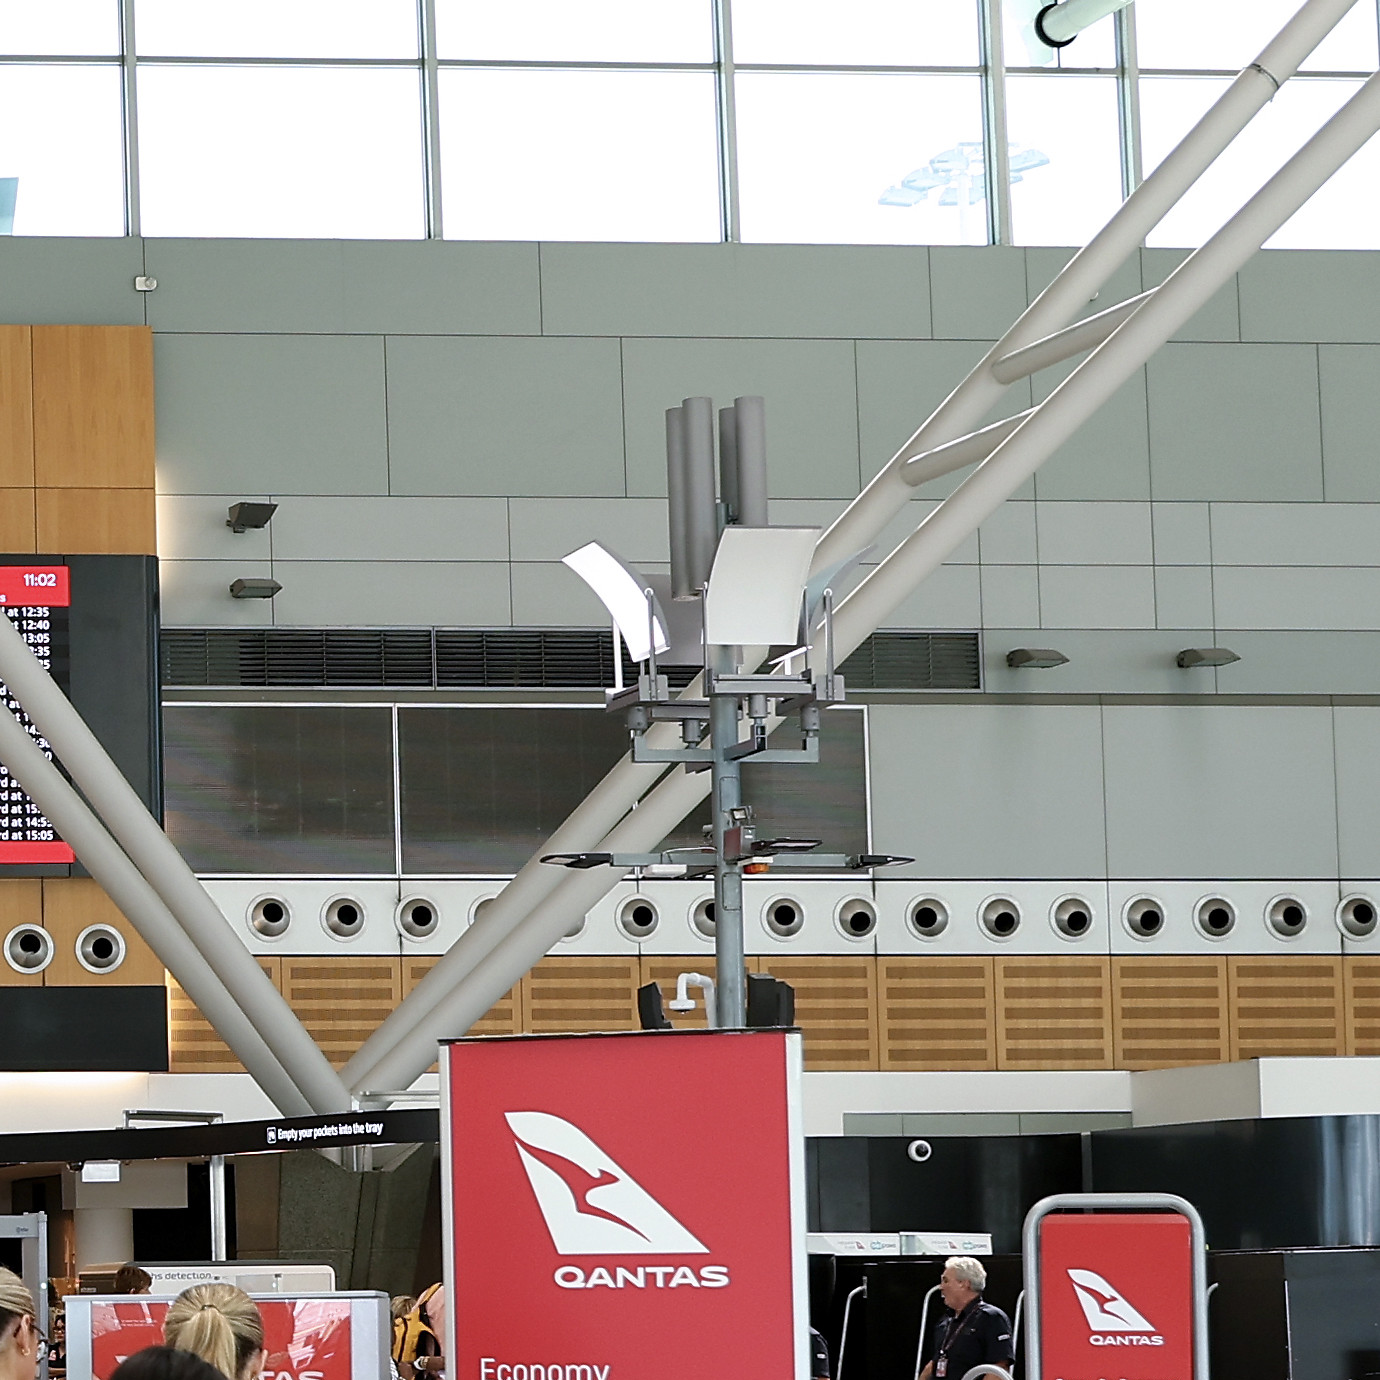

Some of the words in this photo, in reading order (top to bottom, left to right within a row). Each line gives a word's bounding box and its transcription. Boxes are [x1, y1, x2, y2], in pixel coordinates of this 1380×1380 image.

[24, 574, 56, 586] 11:02
[278, 1129, 299, 1141] Empty
[298, 1129, 314, 1141] your
[353, 1123, 365, 1134] the
[365, 1122, 383, 1135] tray
[555, 1266, 729, 1288] QANTAS
[1090, 1335, 1164, 1345] QANTAS
